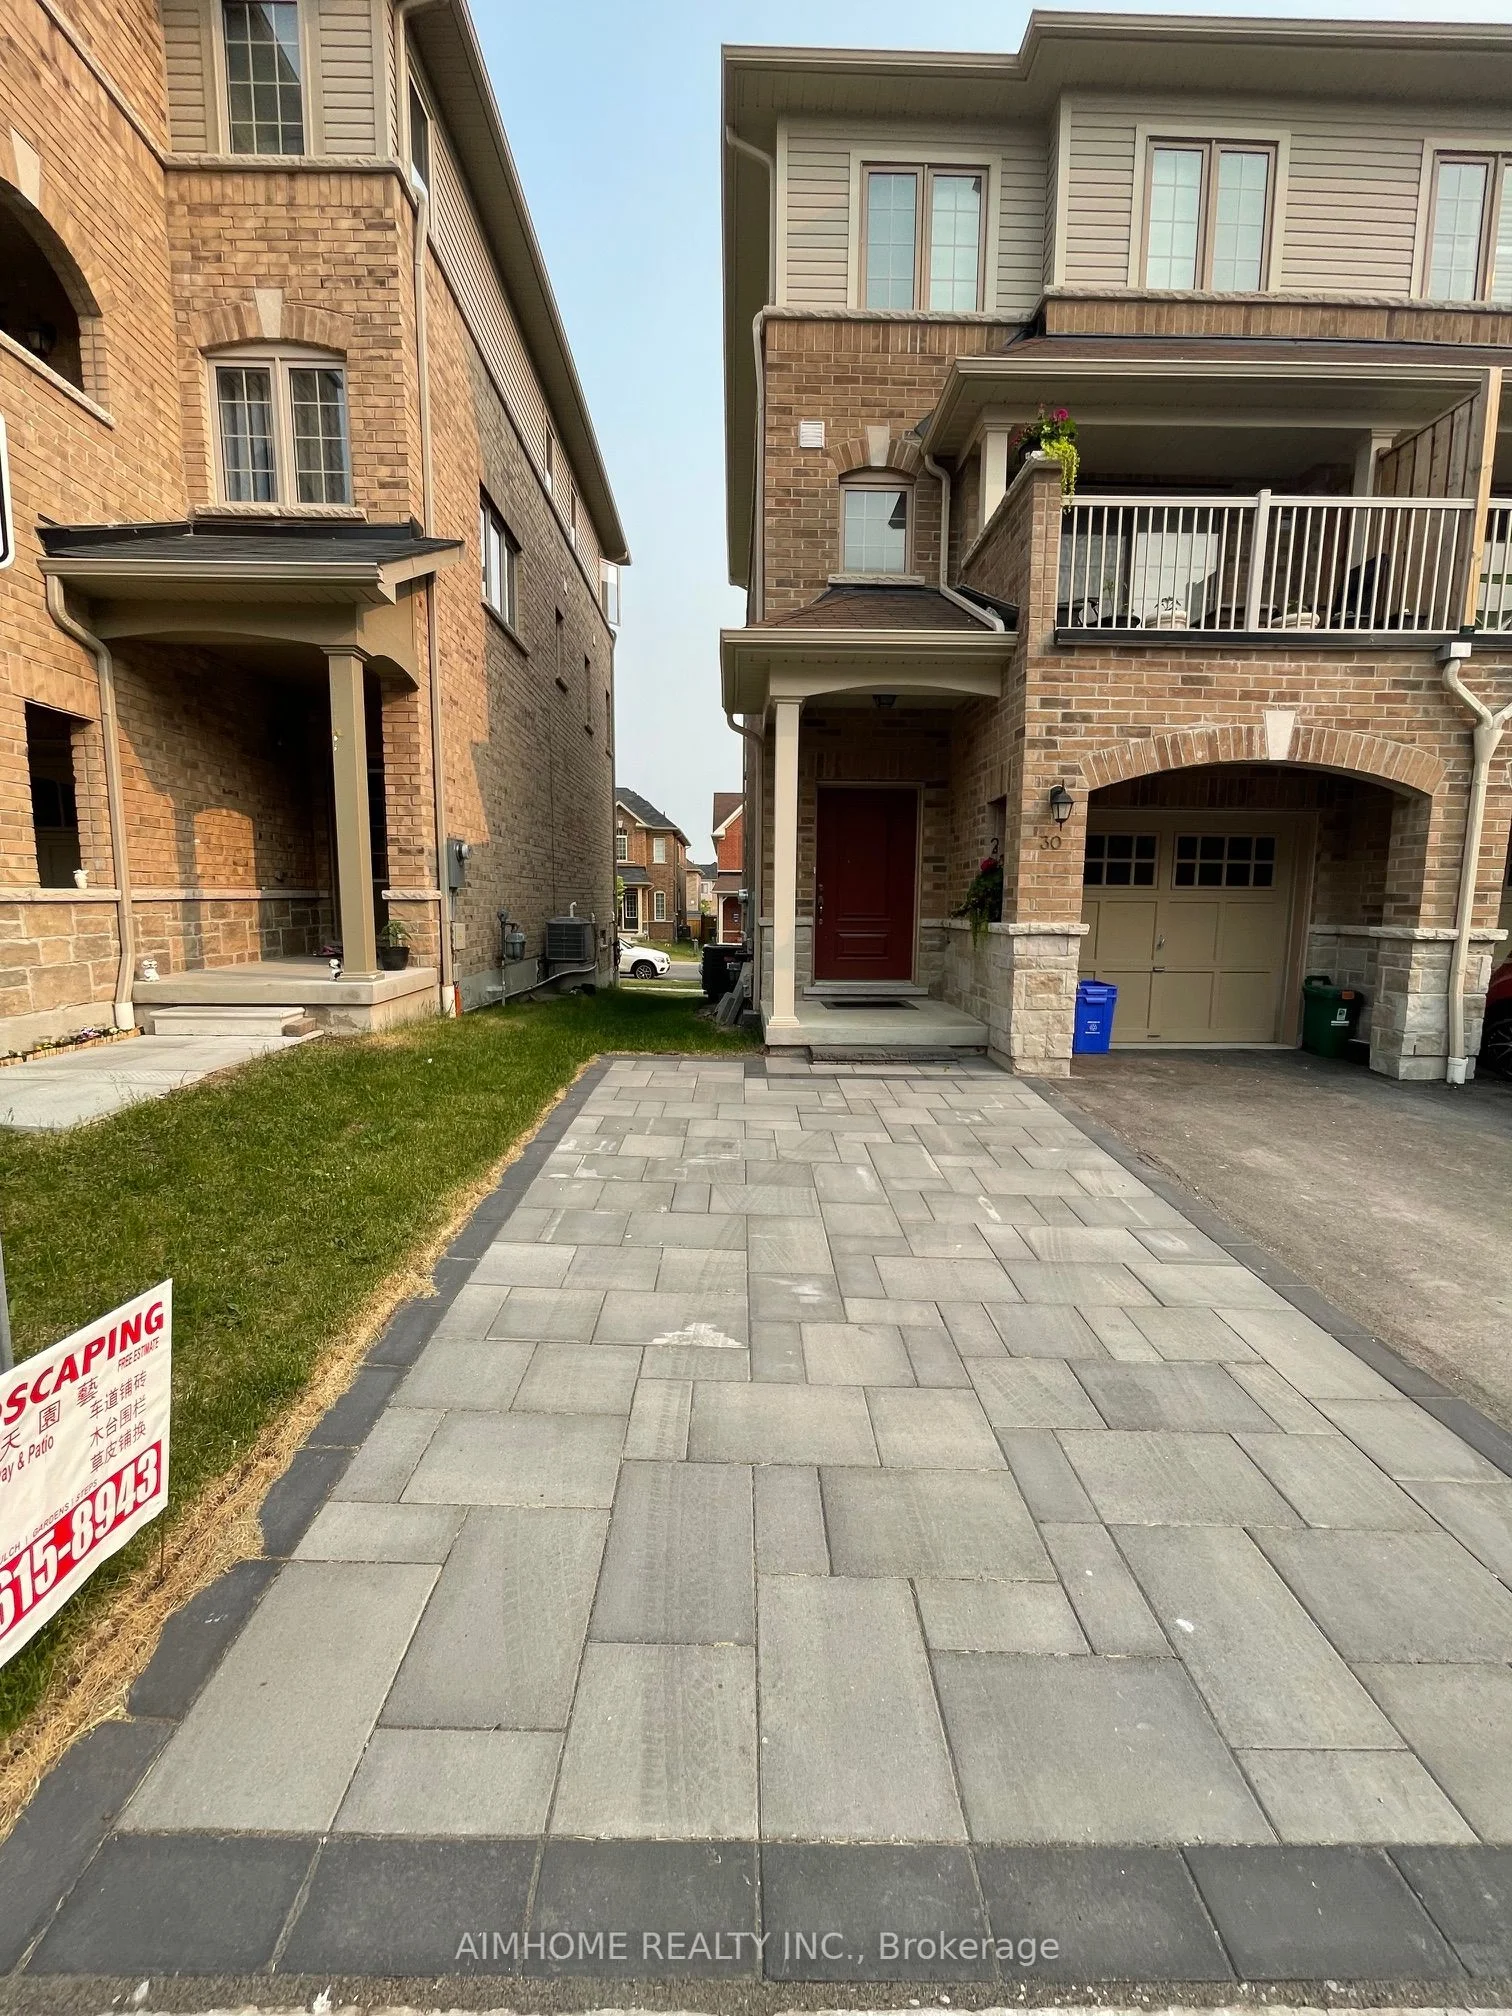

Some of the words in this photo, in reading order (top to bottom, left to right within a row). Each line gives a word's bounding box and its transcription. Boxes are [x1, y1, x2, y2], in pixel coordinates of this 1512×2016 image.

[1040, 836, 1062, 850] 30
[0, 1301, 164, 1426] SCAPING
[118, 1352, 133, 1371] FREE
[133, 1336, 160, 1363] ESTIMATE
[0, 1462, 14, 1483] ay
[17, 1451, 24, 1470] &
[28, 1434, 54, 1464] Patio
[32, 1502, 70, 1538] GARDENS
[76, 1478, 98, 1502] STEPS
